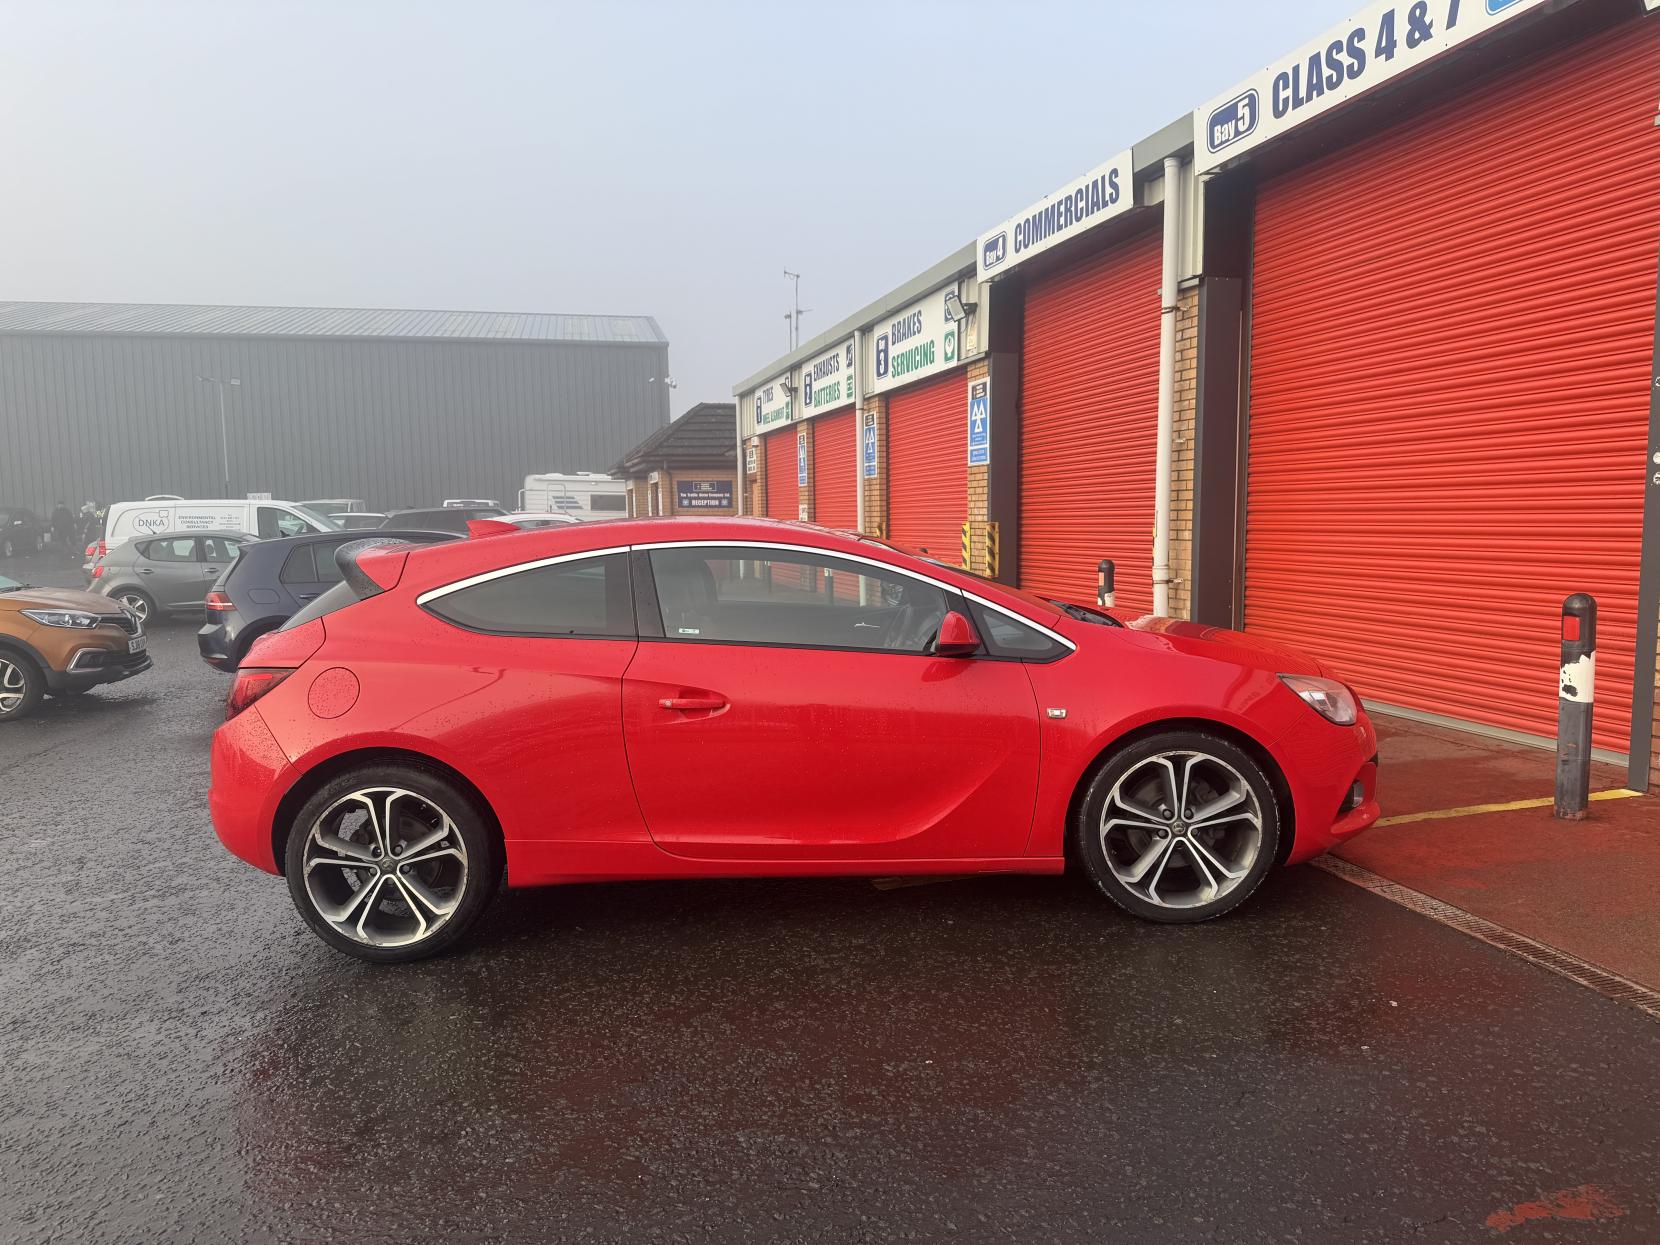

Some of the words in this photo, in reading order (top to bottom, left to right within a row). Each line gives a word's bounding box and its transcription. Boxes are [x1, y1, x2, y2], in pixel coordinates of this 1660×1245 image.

[1272, 27, 1366, 120] CLASS
[1375, 8, 1397, 62] 4
[1406, 0, 1433, 49] &
[1214, 119, 1235, 146] Bay
[1237, 97, 1250, 132] 5
[1014, 167, 1120, 254] COMMERCIALS
[997, 236, 1004, 259] 4
[891, 310, 922, 346] BRAKES
[813, 352, 840, 382] EXHAUSTS
[891, 340, 935, 379] SERVICING
[813, 381, 841, 408] BATTERIES
[138, 519, 165, 527] DNKA
